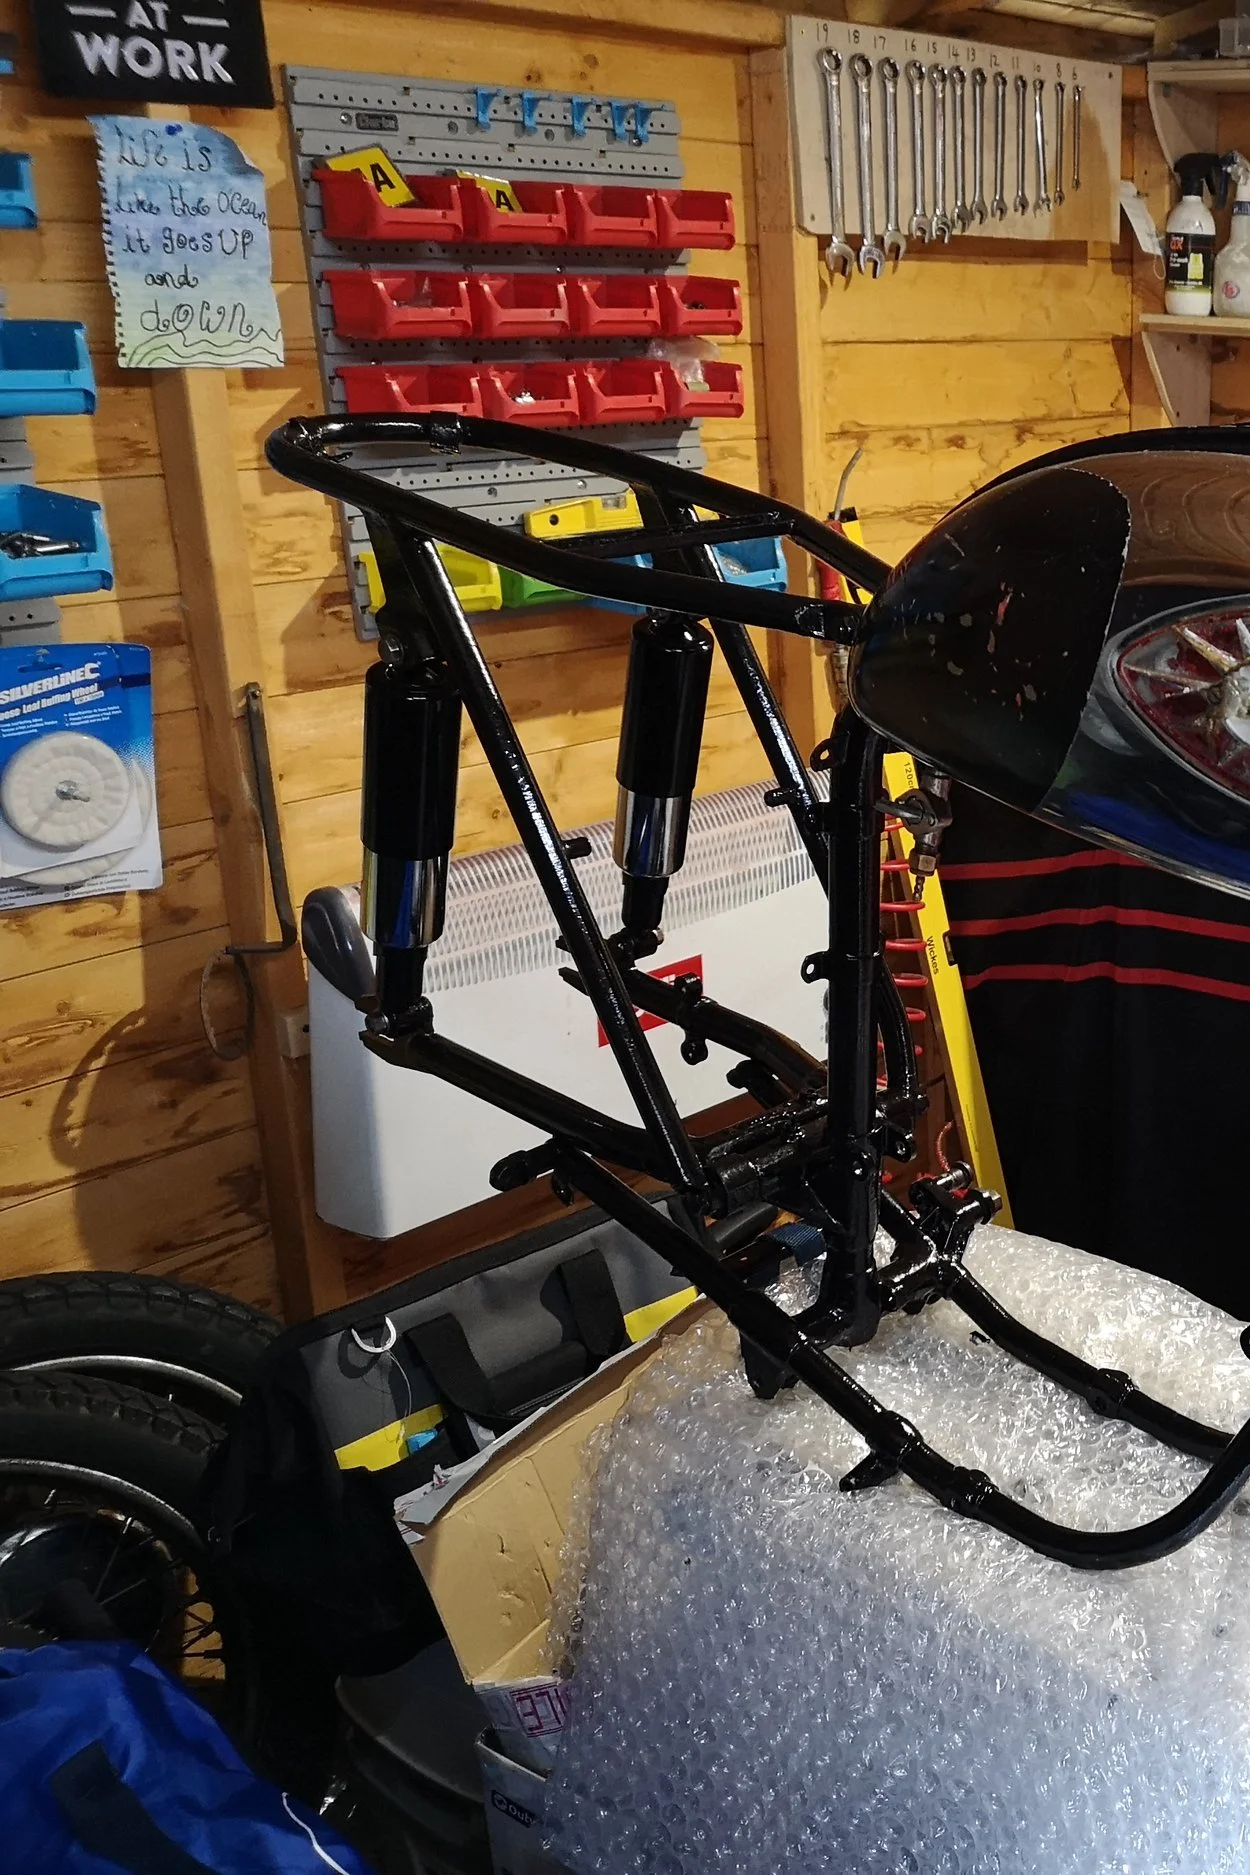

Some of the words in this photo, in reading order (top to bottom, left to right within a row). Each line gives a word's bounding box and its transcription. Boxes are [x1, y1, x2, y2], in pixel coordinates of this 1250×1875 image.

[126, 0, 169, 31] AT
[71, 31, 236, 85] WORK
[816, 22, 829, 43] 19
[847, 29, 860, 44] 18
[873, 35, 887, 50] 17
[904, 38, 917, 52] 16
[927, 41, 938, 54] 15
[947, 43, 960, 62] 14
[966, 46, 977, 63] 13
[989, 53, 1000, 69] 12
[1012, 56, 1020, 69] 11
[1056, 63, 1063, 78] 8
[1072, 66, 1078, 80] 6
[182, 140, 212, 172] is
[369, 162, 396, 193] A
[168, 182, 211, 217] the
[495, 189, 513, 212] A
[122, 225, 150, 252] it
[144, 264, 199, 289] and
[0, 665, 87, 705] SILVERLINE
[926, 935, 940, 975] Wickes
